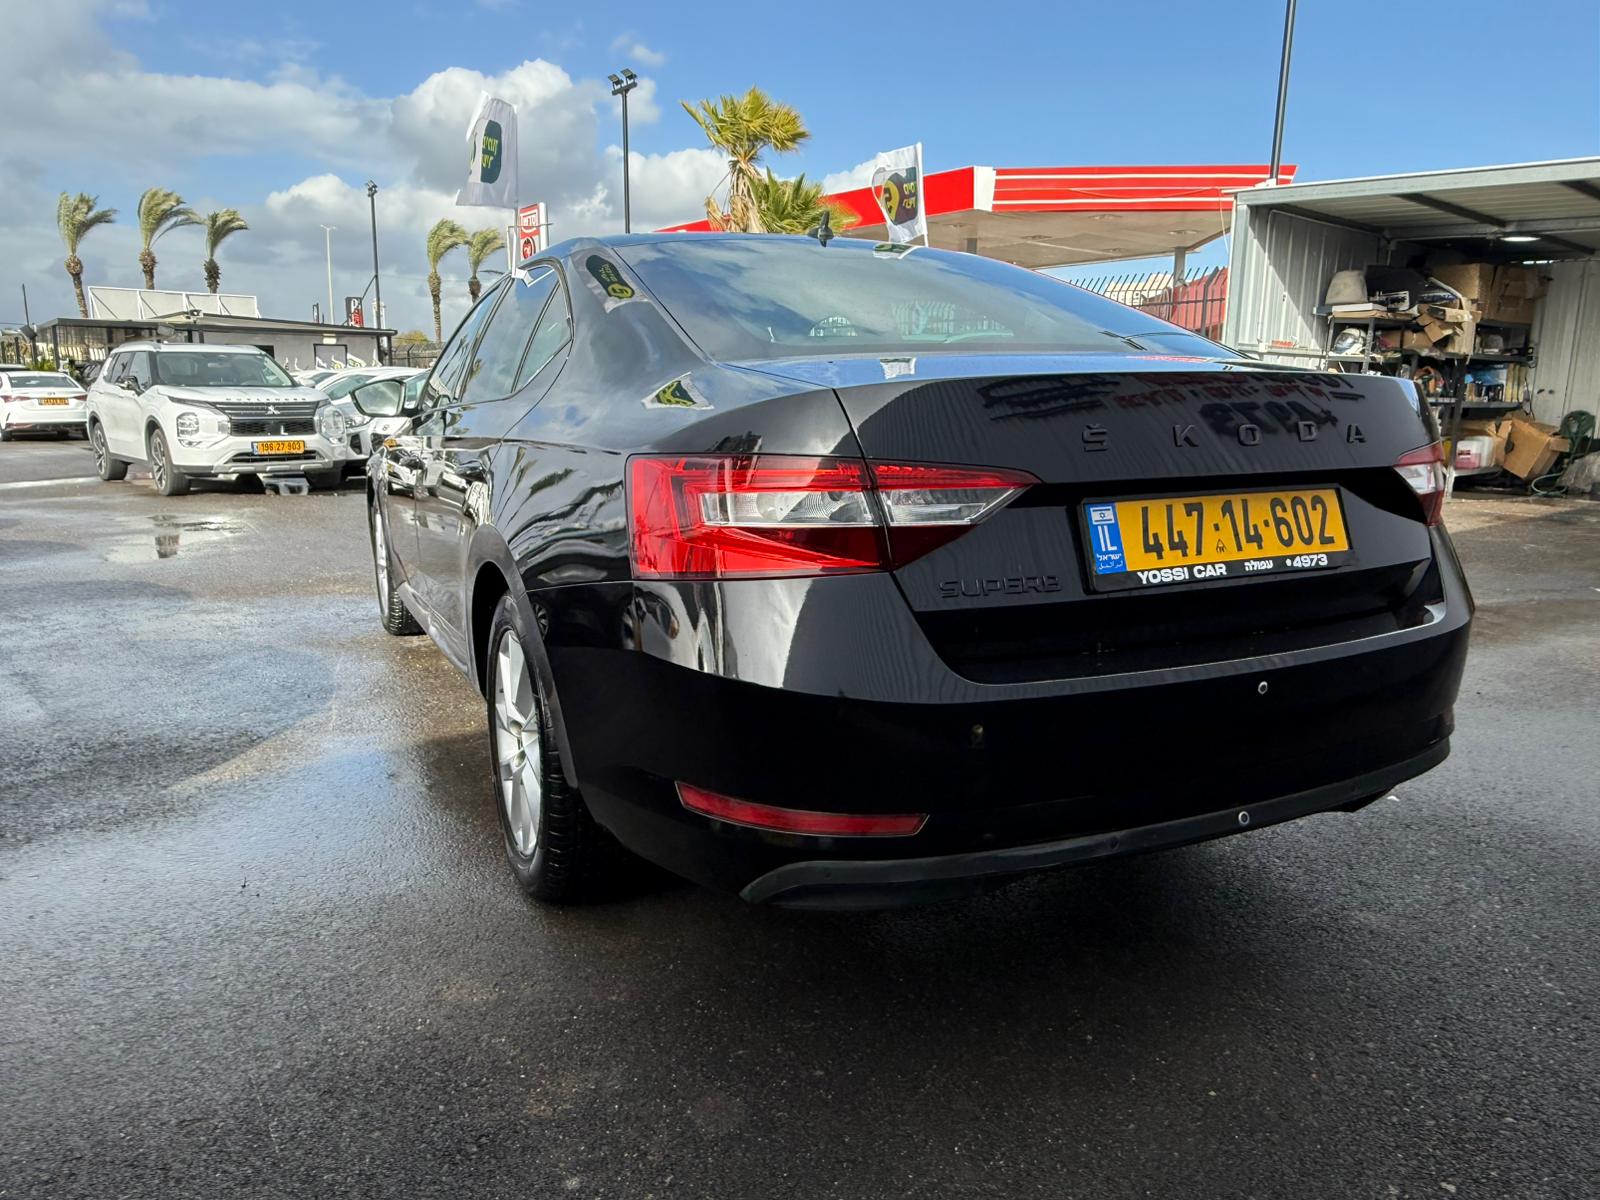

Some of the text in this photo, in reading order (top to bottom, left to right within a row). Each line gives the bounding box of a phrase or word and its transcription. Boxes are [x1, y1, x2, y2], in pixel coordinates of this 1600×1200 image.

[1097, 525, 1118, 551] IL
[1096, 553, 1122, 561] ישראל
[1137, 567, 1189, 585] YOSSI
[1193, 563, 1227, 577] CAR
[1244, 559, 1274, 572] עפולה
[938, 575, 1062, 599] SUPERB
